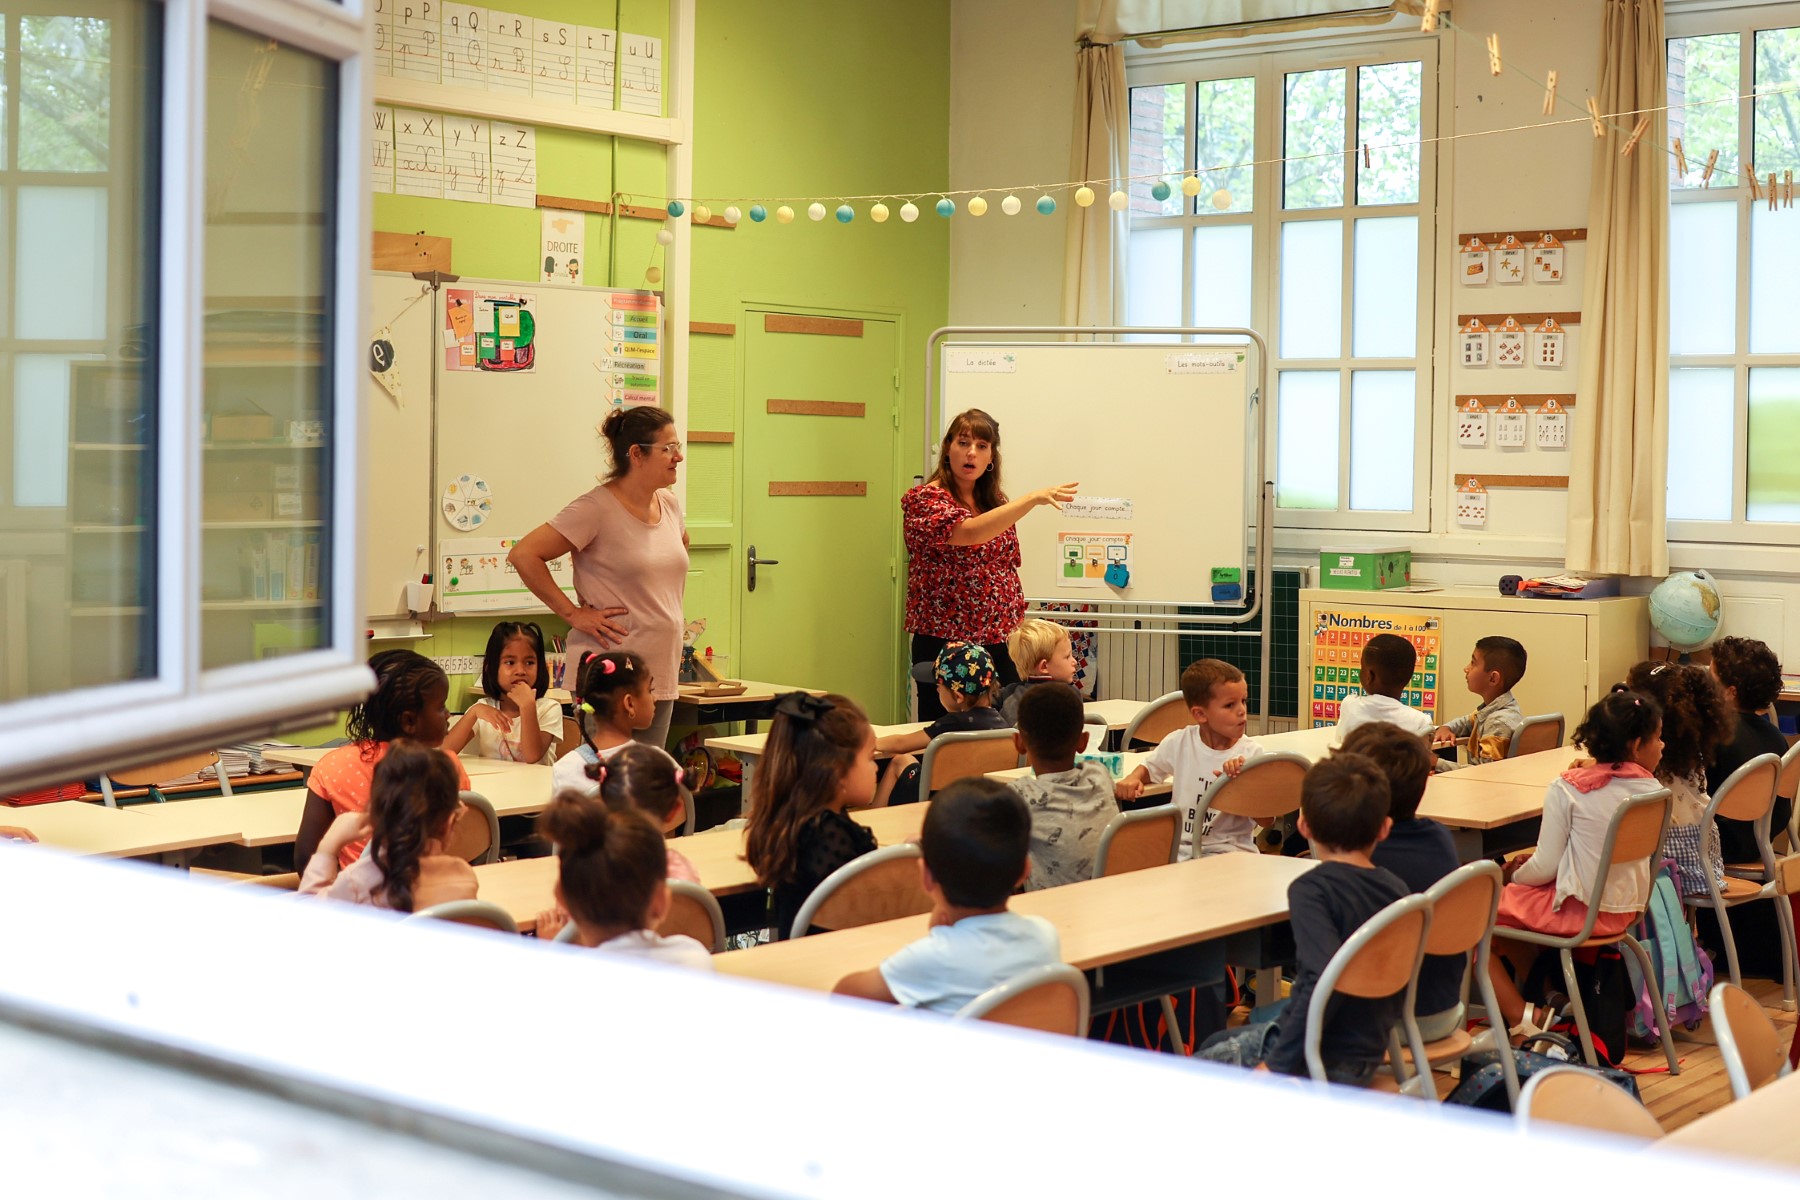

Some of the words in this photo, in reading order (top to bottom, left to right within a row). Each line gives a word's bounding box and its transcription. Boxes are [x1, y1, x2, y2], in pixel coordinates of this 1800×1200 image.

[423, 1, 431, 20] P
[468, 11, 479, 33] Q
[515, 19, 522, 38] R
[558, 27, 567, 46] S
[601, 33, 610, 51] T
[645, 41, 654, 59] U
[422, 117, 435, 137] X
[470, 123, 480, 142] Y
[516, 129, 527, 149] Z
[547, 240, 579, 254] DROITE
[633, 331, 648, 340] Oral
[614, 361, 645, 370] Récréation
[966, 358, 974, 366] La
[978, 358, 996, 366] dictée
[1177, 360, 1188, 368] Les
[1065, 503, 1087, 512] Chaque
[1089, 505, 1102, 513] jour
[1329, 613, 1392, 630] Nombres
[439, 658, 450, 671] 56
[451, 658, 463, 671] 57
[463, 658, 473, 670] 58
